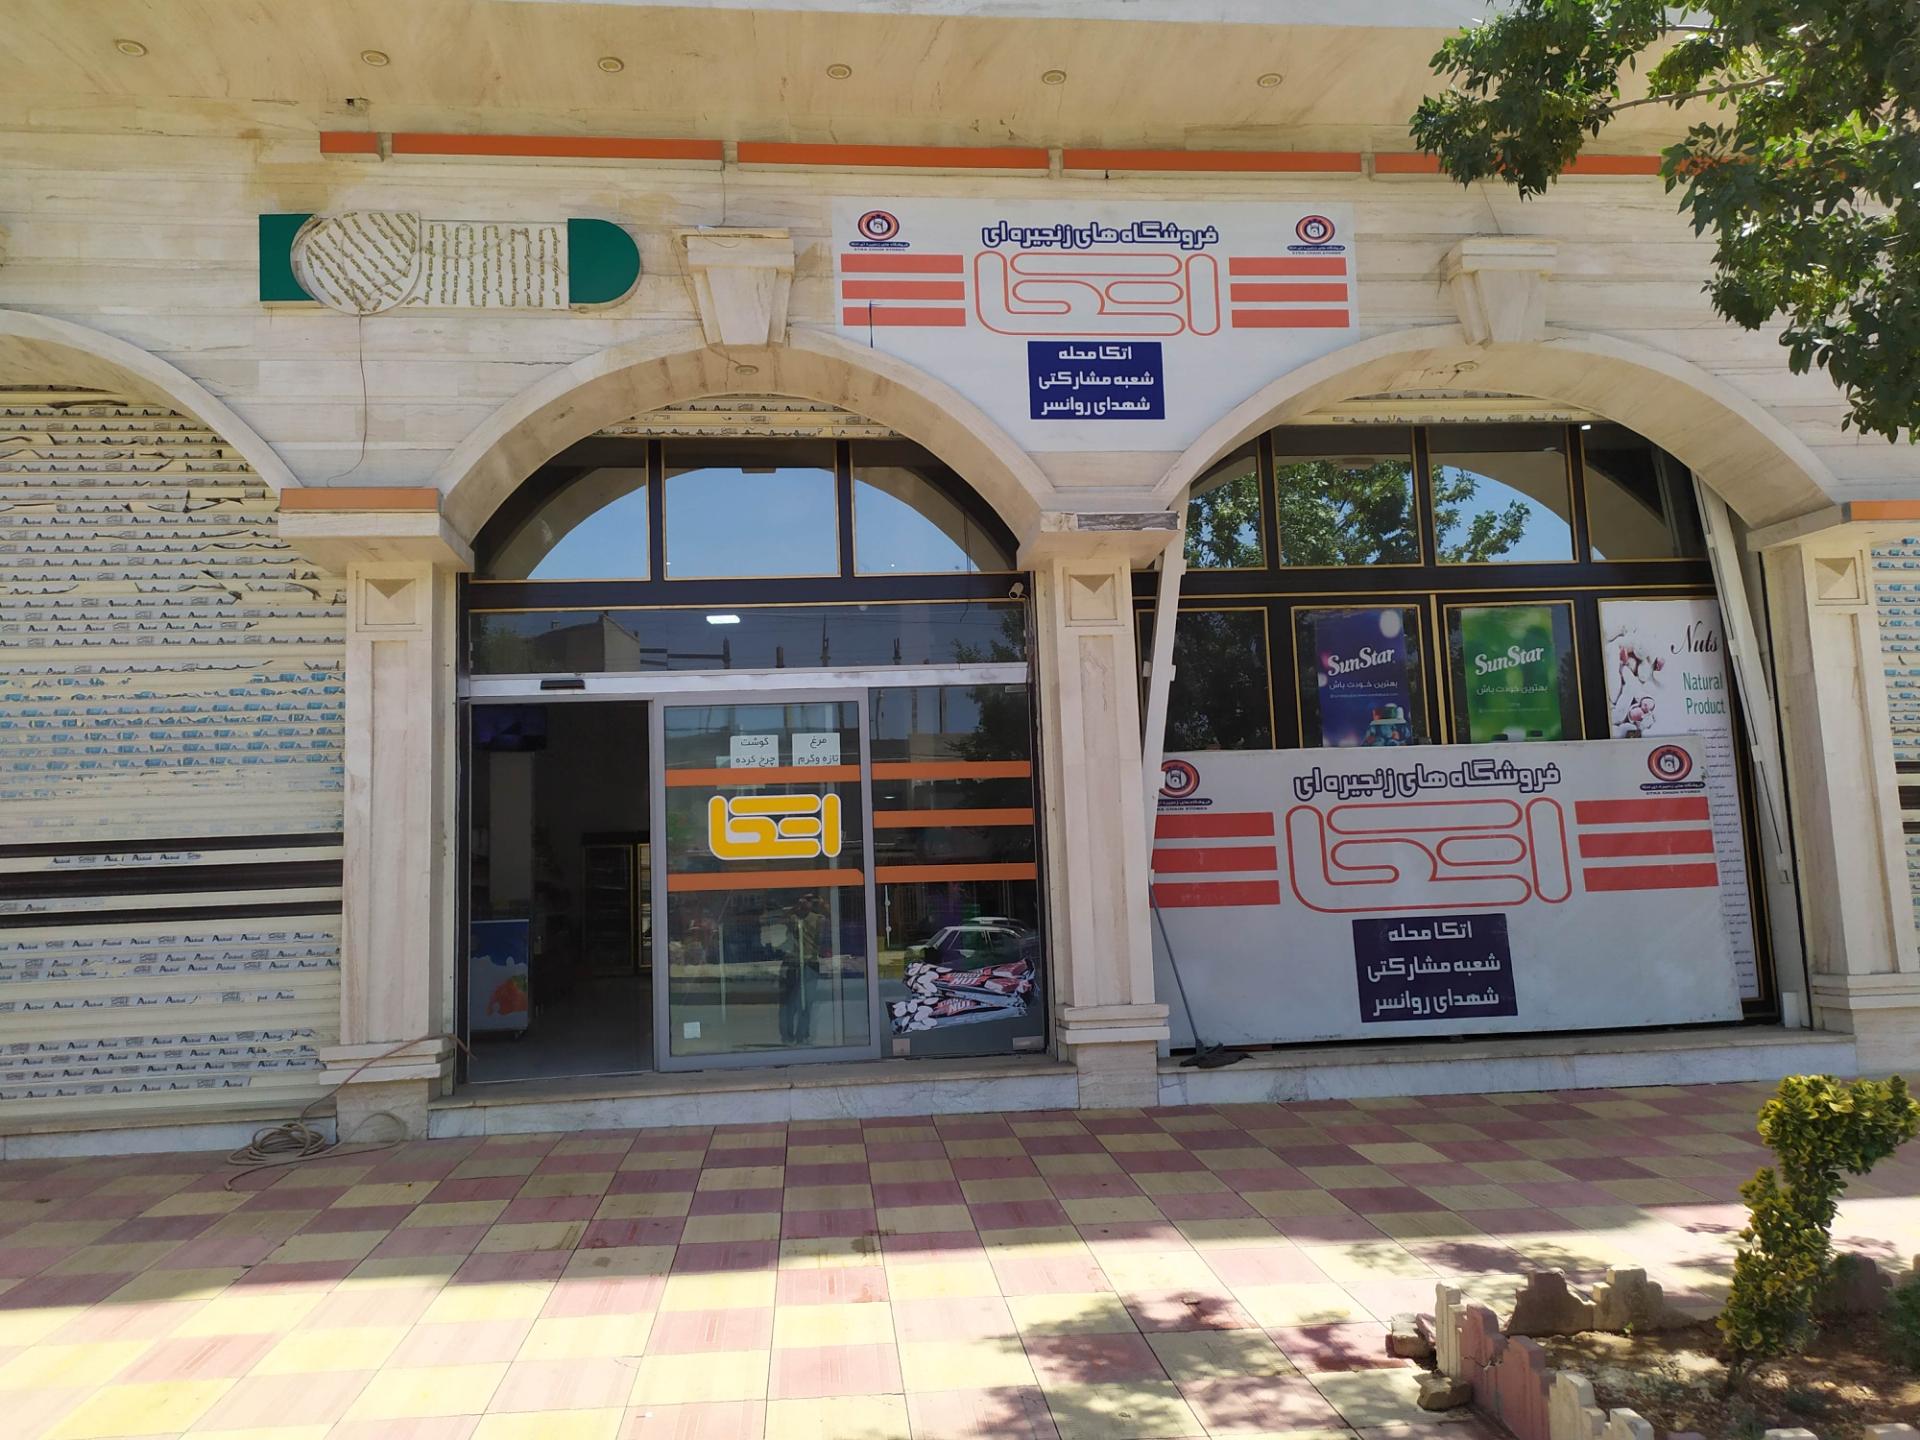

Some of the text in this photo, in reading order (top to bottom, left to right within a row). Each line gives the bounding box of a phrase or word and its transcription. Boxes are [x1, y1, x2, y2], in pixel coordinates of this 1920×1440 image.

[981, 220, 1219, 250] فروشگاه های زنجیره ای
[1058, 345, 1132, 360] اتکا محله
[1038, 370, 1154, 390] شعبه مشارکتی
[1040, 396, 1150, 416] شهدای روانسر
[1670, 620, 1718, 655] Nuts
[1327, 647, 1395, 676] SunStar
[1474, 645, 1545, 675] SunStar
[1682, 671, 1723, 690] Natural
[1684, 697, 1726, 715] Product
[810, 735, 827, 749] مرغ
[735, 755, 776, 768] چرخ کرده
[822, 754, 839, 765] تازه
[1293, 759, 1561, 801] فروشگاه های زنجیره ای
[1388, 920, 1472, 941] اتکا محله
[1367, 952, 1501, 983] شعبه مشارکتی
[1372, 986, 1499, 1017] شهدای روانسر
